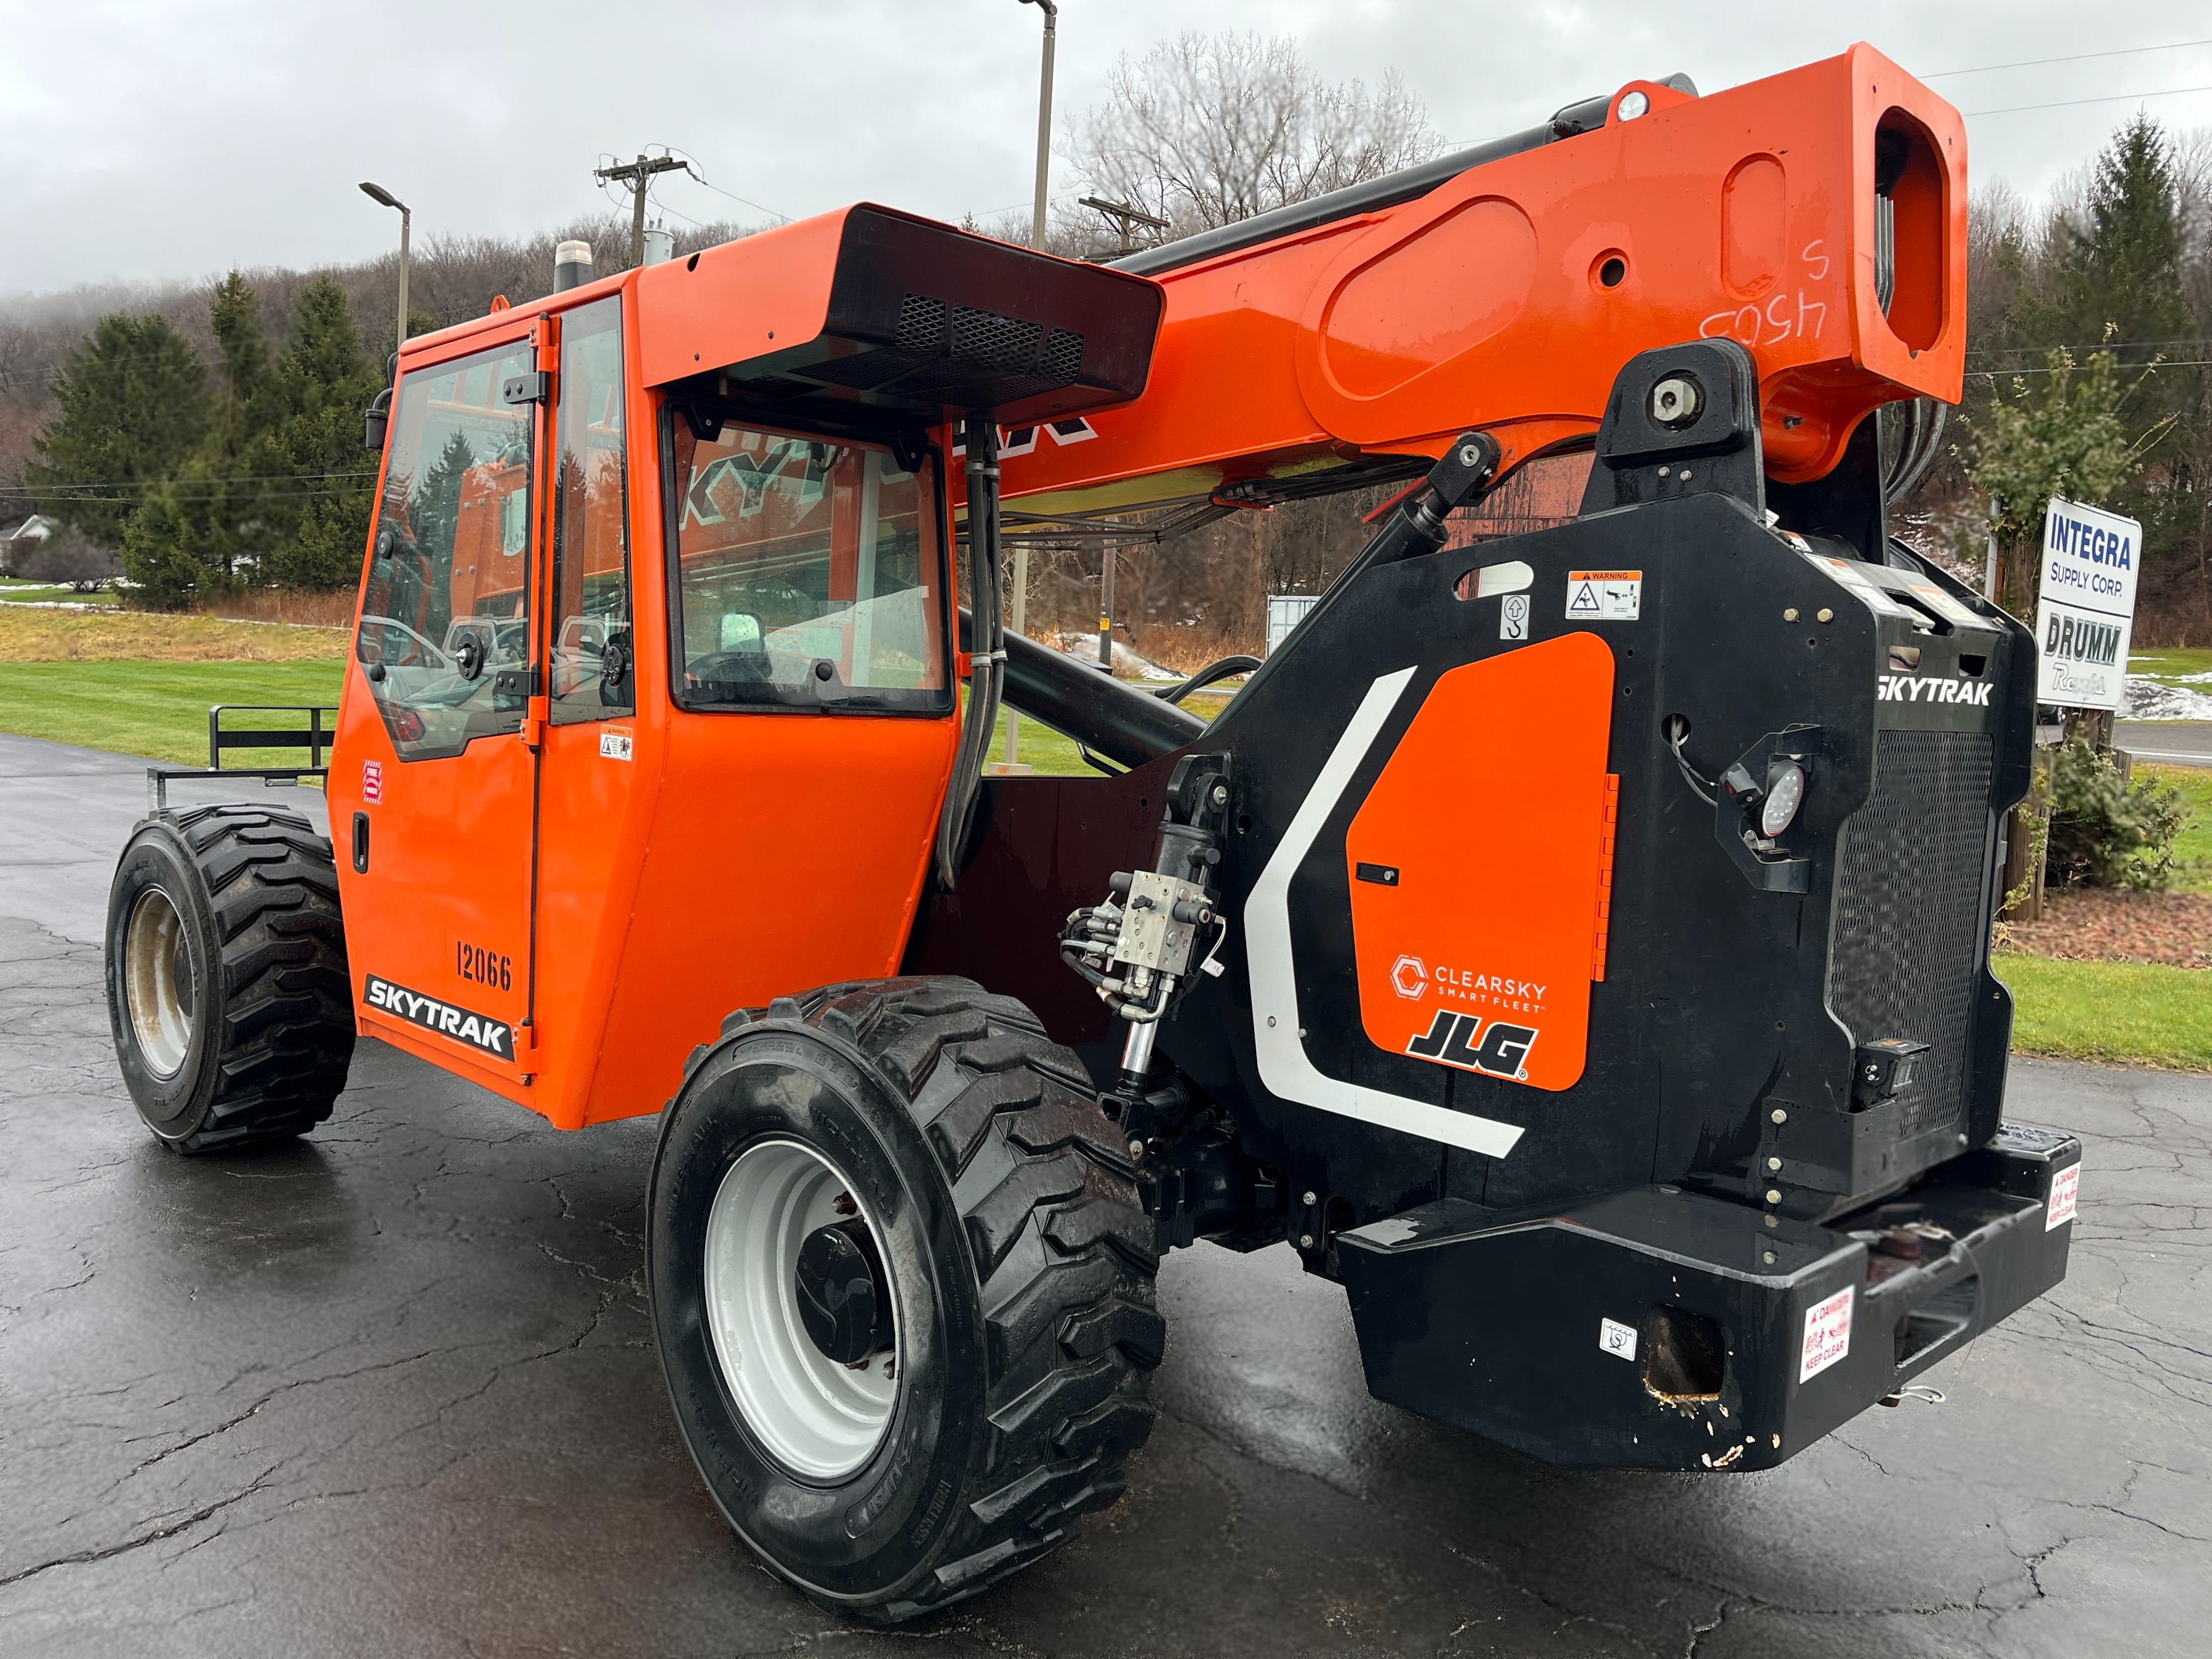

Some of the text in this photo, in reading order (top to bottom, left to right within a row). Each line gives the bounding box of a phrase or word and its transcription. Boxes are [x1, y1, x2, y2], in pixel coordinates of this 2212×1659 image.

[2050, 514, 2131, 571] INTEGRA
[2051, 561, 2122, 597] SUPPLY CORP.
[2044, 612, 2122, 667] DRUMM
[458, 941, 511, 992] 12066
[1435, 966, 1547, 1001] CLEARSKY
[1438, 986, 1486, 1004] SMART
[369, 980, 507, 1052] SKYTRAK
[2060, 1168, 2078, 1184] DANGER
[2050, 1204, 2074, 1224] KEEP CLEAR
[1805, 1340, 1844, 1372] KEEP CLEAR
